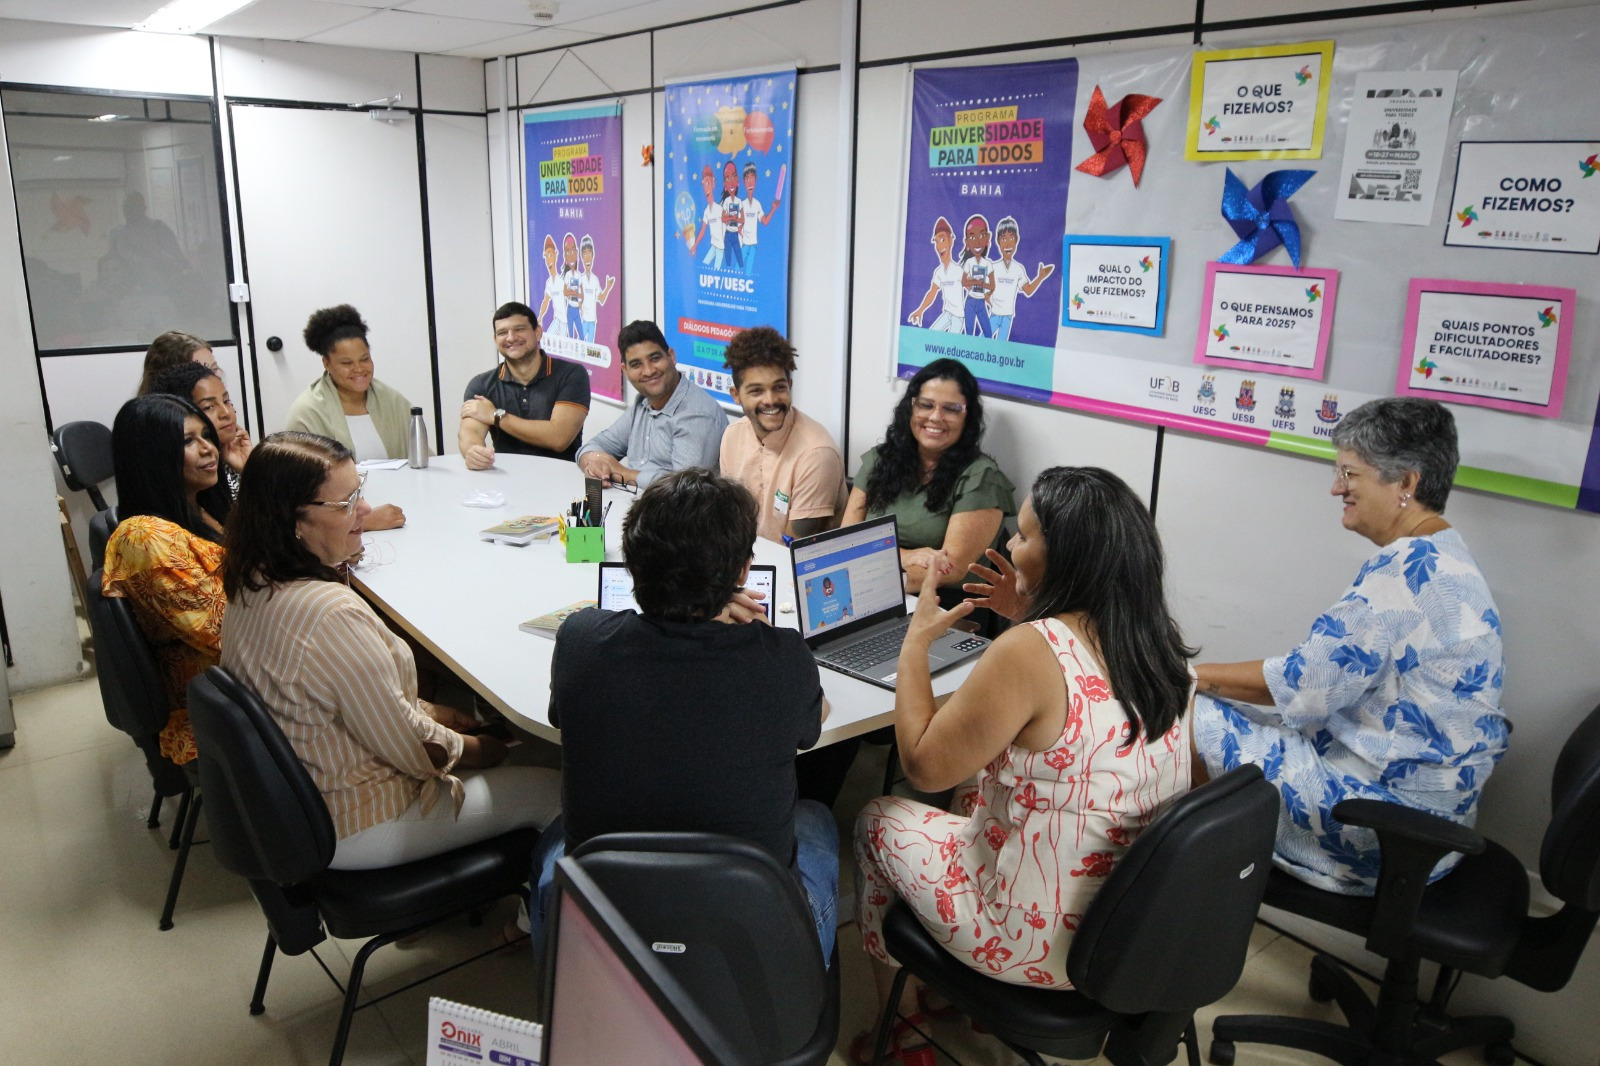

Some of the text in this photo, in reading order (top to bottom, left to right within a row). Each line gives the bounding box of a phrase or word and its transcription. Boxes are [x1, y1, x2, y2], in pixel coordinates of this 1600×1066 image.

[1237, 84, 1282, 98] O QUE
[1223, 100, 1293, 115] FIZEMOS?
[957, 110, 1015, 123] PROGRAMA
[932, 121, 1041, 146] UNIVERSIDADE
[554, 146, 587, 157] PROGRAMA
[938, 143, 1033, 165] PARA TODOS
[540, 157, 602, 178] UNIVERSIDADE
[545, 177, 598, 195] PARA TODOS
[961, 184, 1002, 195] BAHIA
[1500, 177, 1562, 192] COMO
[1482, 197, 1574, 213] FIZEMOS?
[559, 208, 583, 218] BAHIA
[1099, 264, 1131, 273] QUAL O
[699, 274, 754, 293] UPT/UESC
[1087, 275, 1142, 286] IMPACTO DO
[1083, 286, 1146, 297] QUE FIZEMOS?
[1220, 302, 1313, 318] O QUE PENSAMOS
[683, 321, 709, 334] DIÁLOGOS
[1236, 315, 1296, 329] PARA 2025?
[1442, 320, 1535, 336] QUAIS PONTOS
[1434, 332, 1540, 351] DIFICULTADORES
[924, 343, 1025, 368] www.educacao.ba.gov.br
[1429, 344, 1541, 365] E FACILITADORES?
[1193, 405, 1216, 416] UESC
[1232, 412, 1255, 423] UESB
[1272, 419, 1295, 431] UEFS
[1313, 426, 1333, 437] UNE
[491, 1038, 522, 1053] ABRIL
